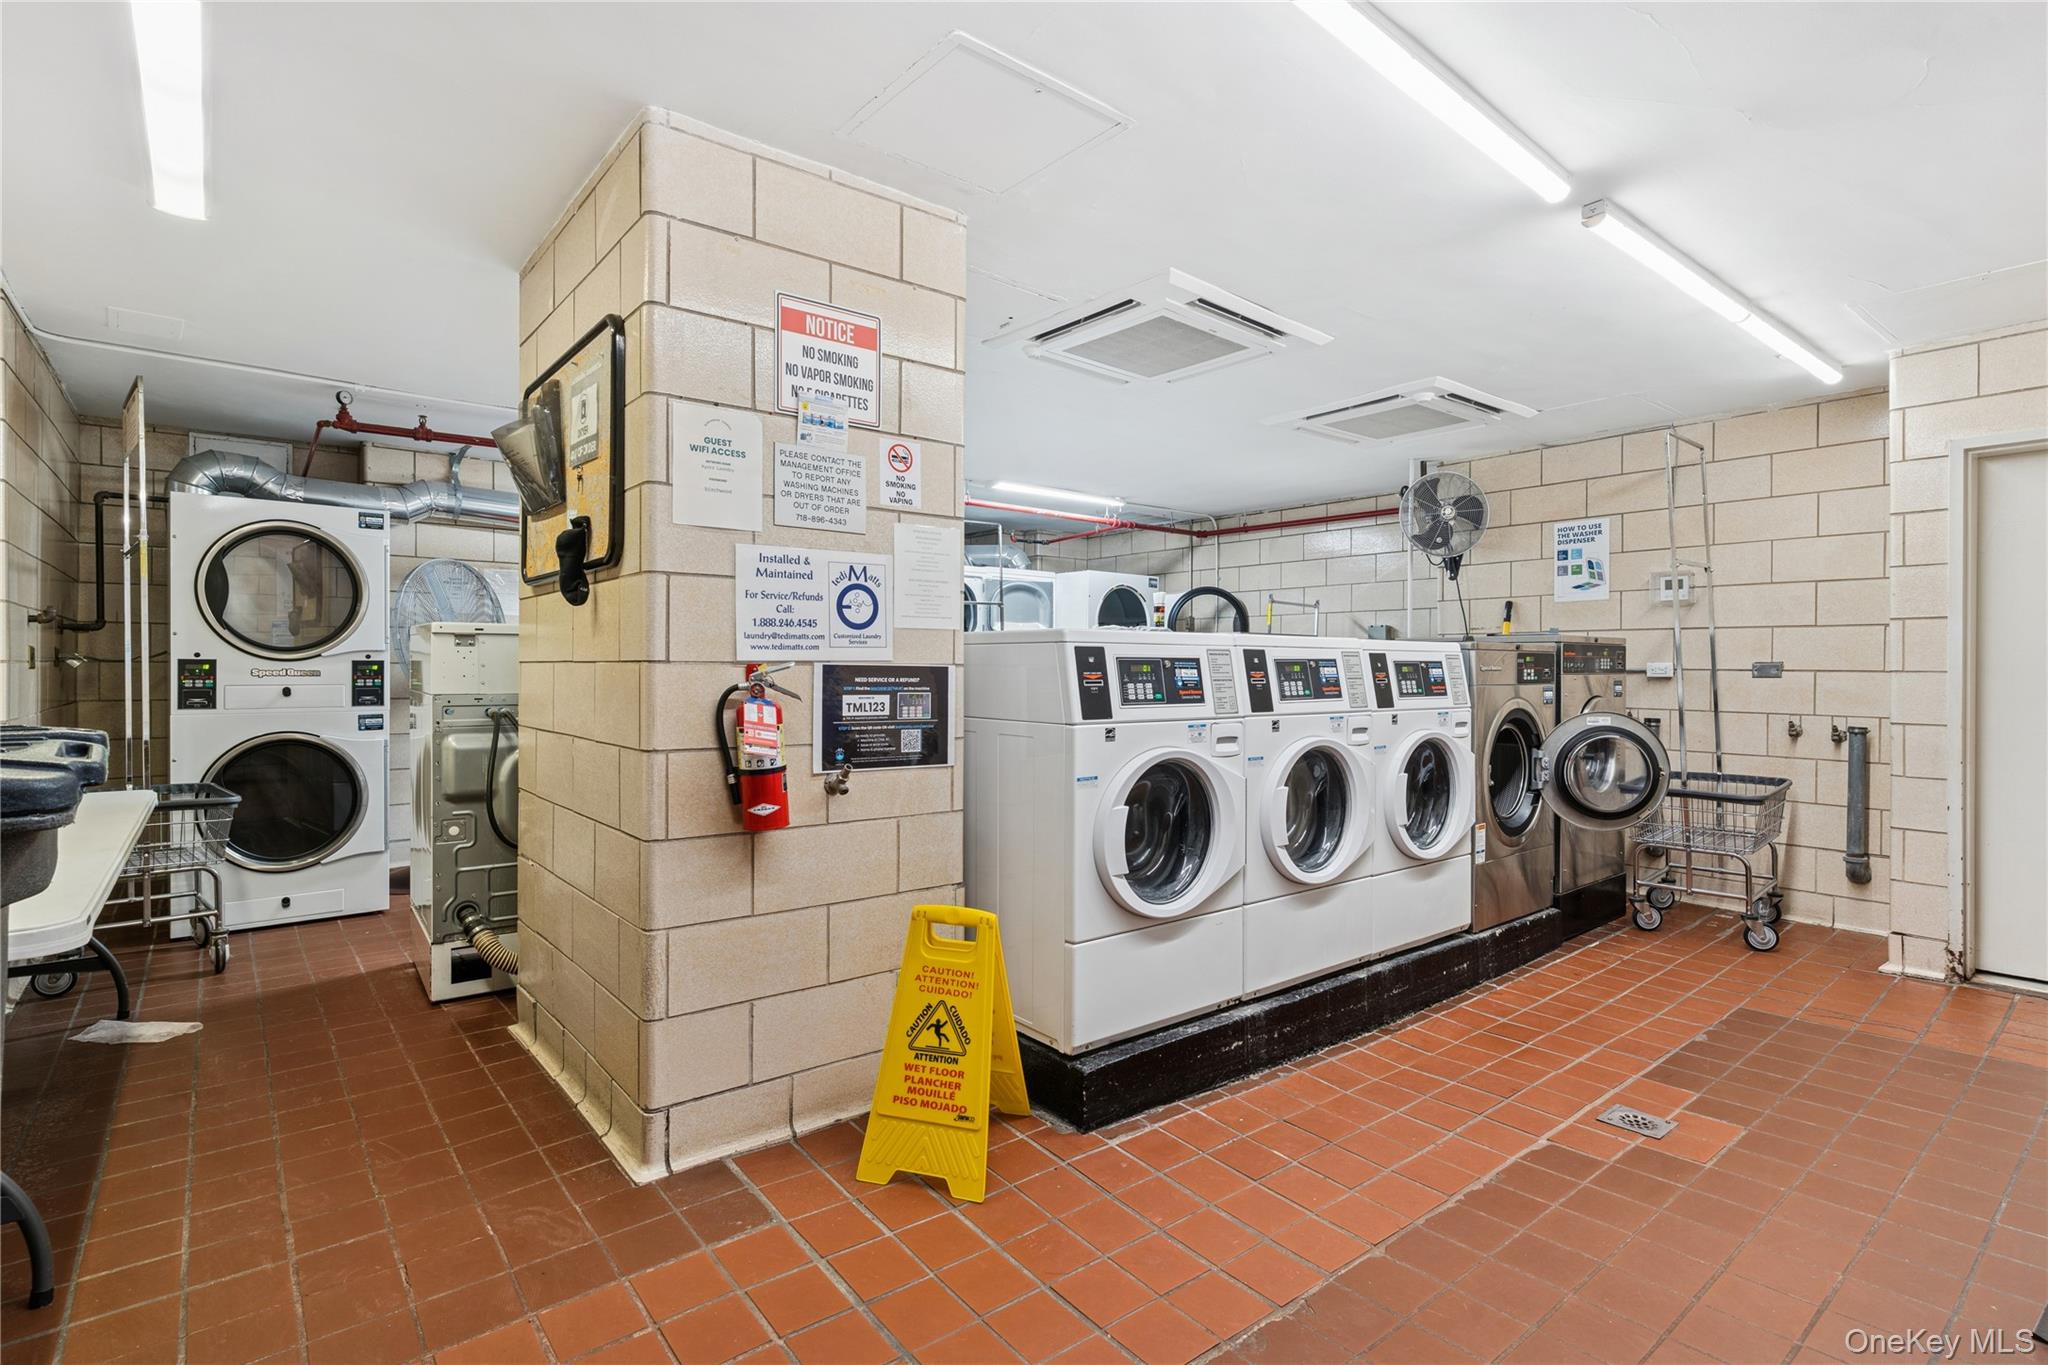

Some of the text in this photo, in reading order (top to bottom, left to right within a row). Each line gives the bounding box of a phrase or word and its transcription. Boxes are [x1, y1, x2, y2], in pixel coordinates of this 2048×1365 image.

[806, 314, 855, 344] NOTICE
[802, 345, 858, 368] NO SMOKING
[786, 362, 874, 392] NO VAPOR SMOKING
[704, 436, 732, 447] GUEST
[690, 444, 746, 458] WIFI ACCESS
[780, 449, 862, 468] PLEASE CONTACT THE
[780, 460, 861, 478] MANAGEMENT OFFICE
[792, 471, 802, 479] TO
[805, 473, 834, 483] REPORT
[783, 480, 858, 496] WASHING MACHINES
[885, 480, 916, 490] SMOKING
[794, 492, 824, 502] DRYERS
[826, 496, 845, 504] THAT
[889, 497, 913, 505] VAPING
[793, 501, 809, 509] OUT
[824, 505, 850, 514] ORDER
[796, 514, 846, 526] 718-896-4343
[1572, 530, 1602, 538] WASHER
[1557, 537, 1596, 545] DISPENSER
[759, 552, 810, 565] Installed &
[756, 567, 813, 580] Maintained
[745, 590, 824, 601] For Service/Refunds
[776, 604, 794, 613] Call:
[752, 618, 818, 628] 1.888.246.4545
[744, 632, 825, 641] laundry@tedimatts.com
[251, 668, 321, 678] Speed Queen
[846, 702, 885, 712] TML123
[922, 965, 974, 979] CAUTION!
[915, 974, 979, 989] ATTENTION!
[919, 985, 972, 999] CUIDADO!
[906, 1003, 933, 1038] CAUTION
[950, 1005, 971, 1045] CUIDADO
[914, 1053, 959, 1065] ATTENTION
[904, 1063, 965, 1079] WET FLOOR
[904, 1075, 961, 1090] PLANCHER
[907, 1086, 955, 1101] MOUILLÉ
[893, 1096, 967, 1114] PISO MOJADO
